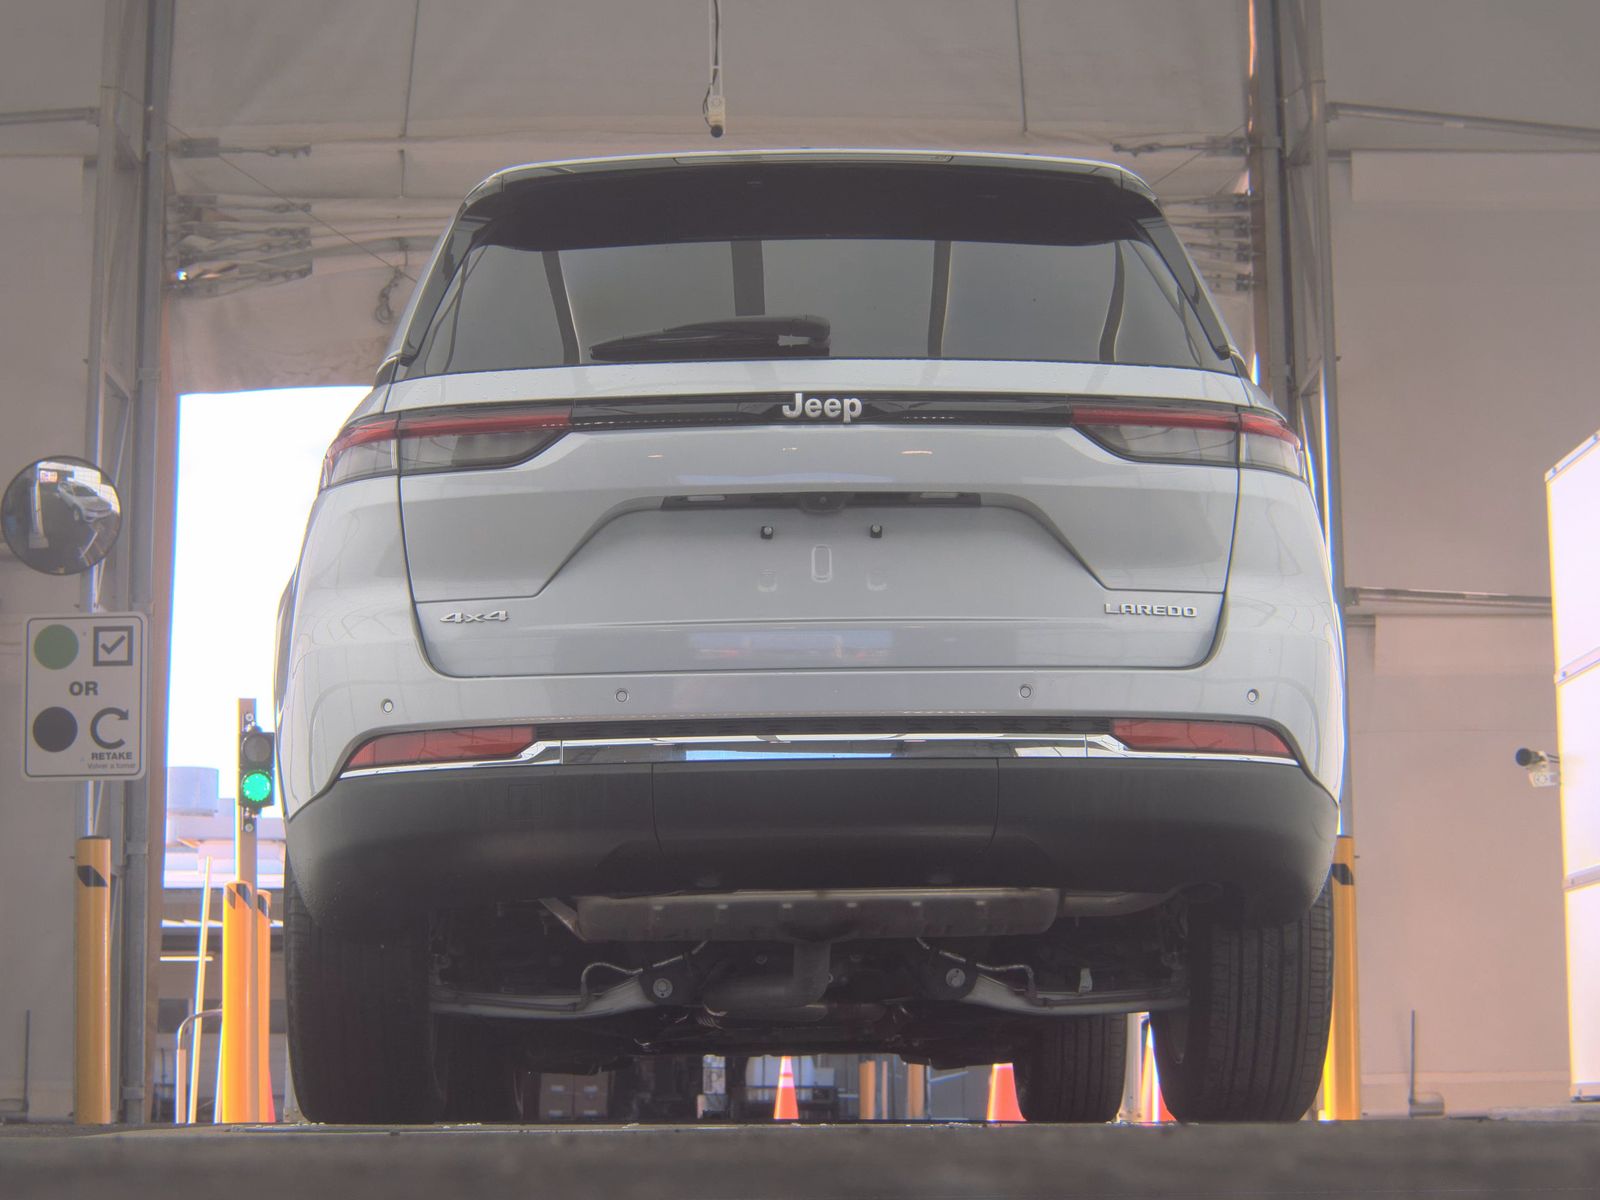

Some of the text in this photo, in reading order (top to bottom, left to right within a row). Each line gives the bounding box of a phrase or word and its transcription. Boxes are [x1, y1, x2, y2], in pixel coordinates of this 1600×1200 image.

[782, 393, 862, 423] Jeep
[440, 610, 508, 623] 4x4
[1104, 603, 1198, 617] LAREDO
[69, 681, 98, 696] OR
[91, 752, 132, 760] RETAKE
